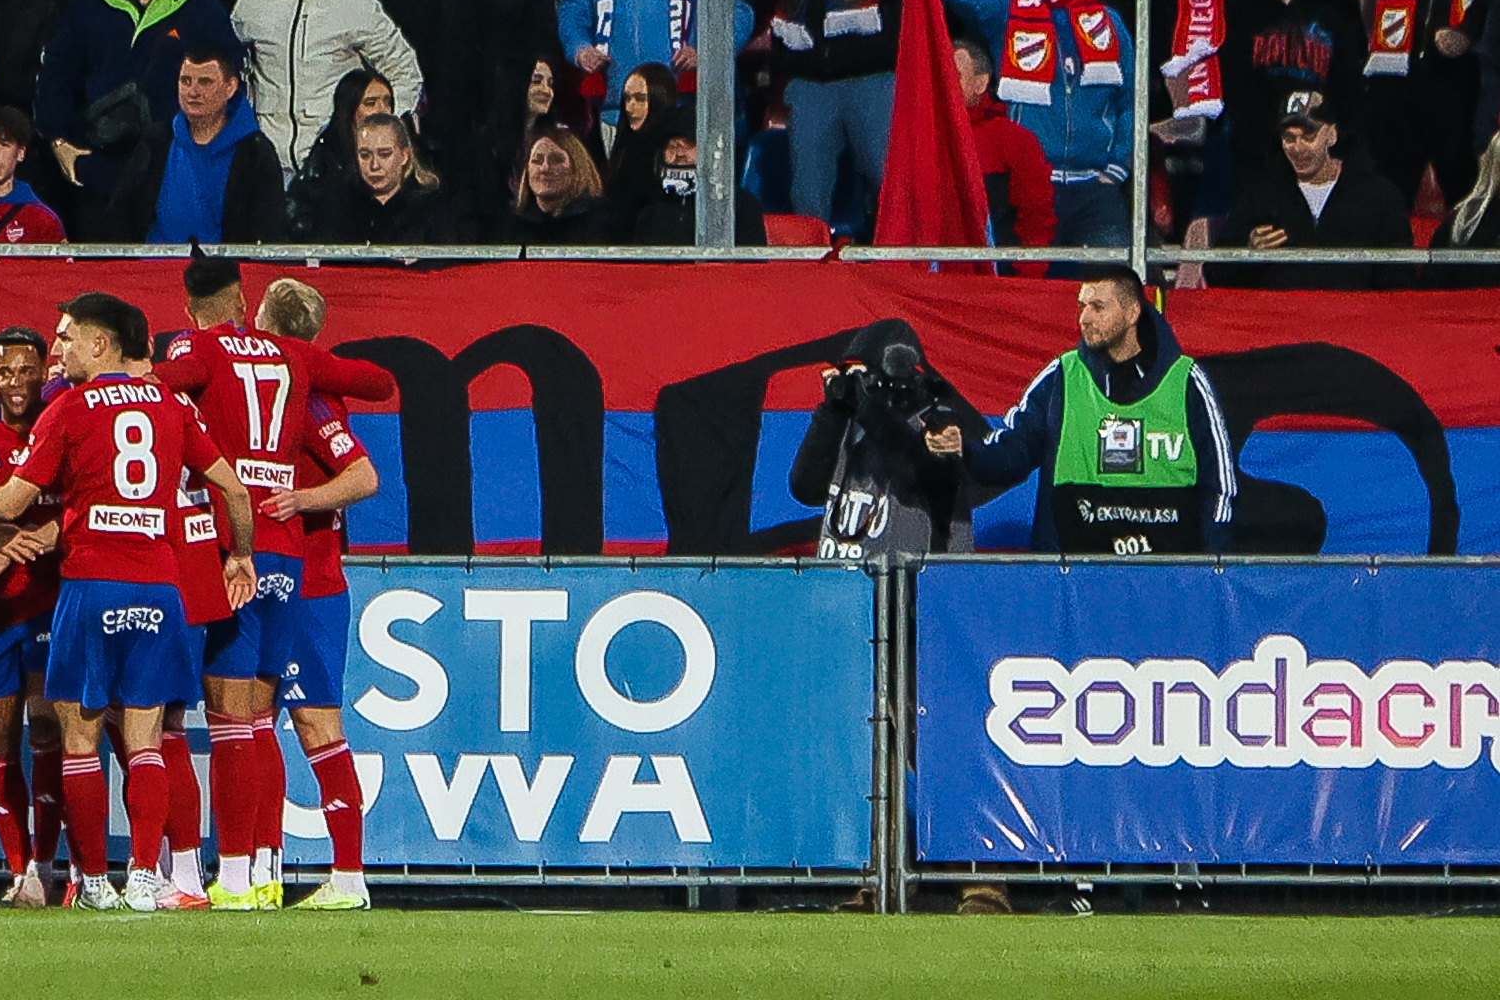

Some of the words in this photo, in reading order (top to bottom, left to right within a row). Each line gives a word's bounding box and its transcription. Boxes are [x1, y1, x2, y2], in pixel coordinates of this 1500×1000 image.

[83, 384, 163, 409] PIENKO
[232, 362, 292, 453] 17
[114, 410, 158, 500] 8
[1146, 432, 1185, 461] TV
[94, 509, 161, 530] NEONET
[1114, 534, 1153, 556] 001
